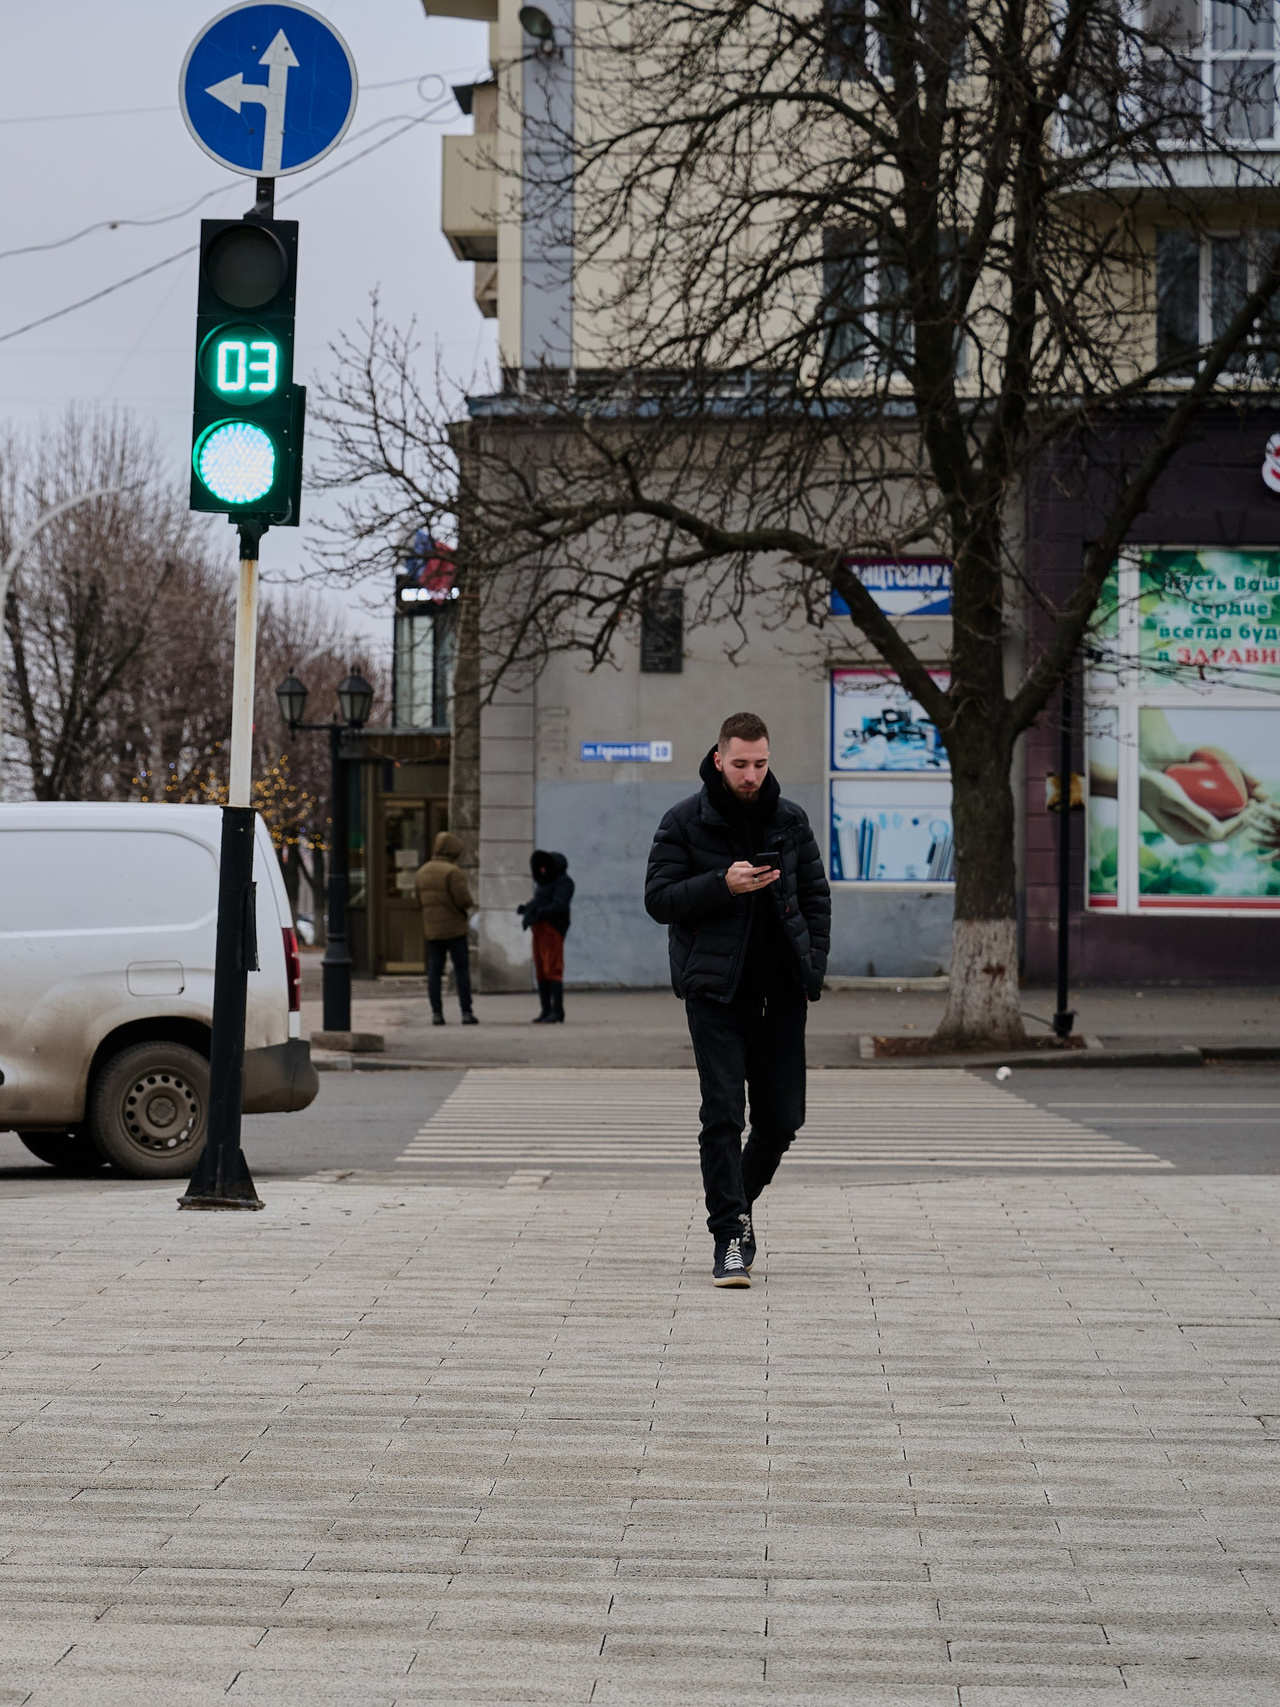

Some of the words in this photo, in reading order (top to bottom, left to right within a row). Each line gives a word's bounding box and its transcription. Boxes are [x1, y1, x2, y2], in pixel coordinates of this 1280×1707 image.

[217, 341, 277, 392] 03
[1191, 602, 1269, 619] сердце
[1159, 626, 1232, 640] всегда
[1238, 622, 1280, 643] буд
[1159, 651, 1169, 662] в
